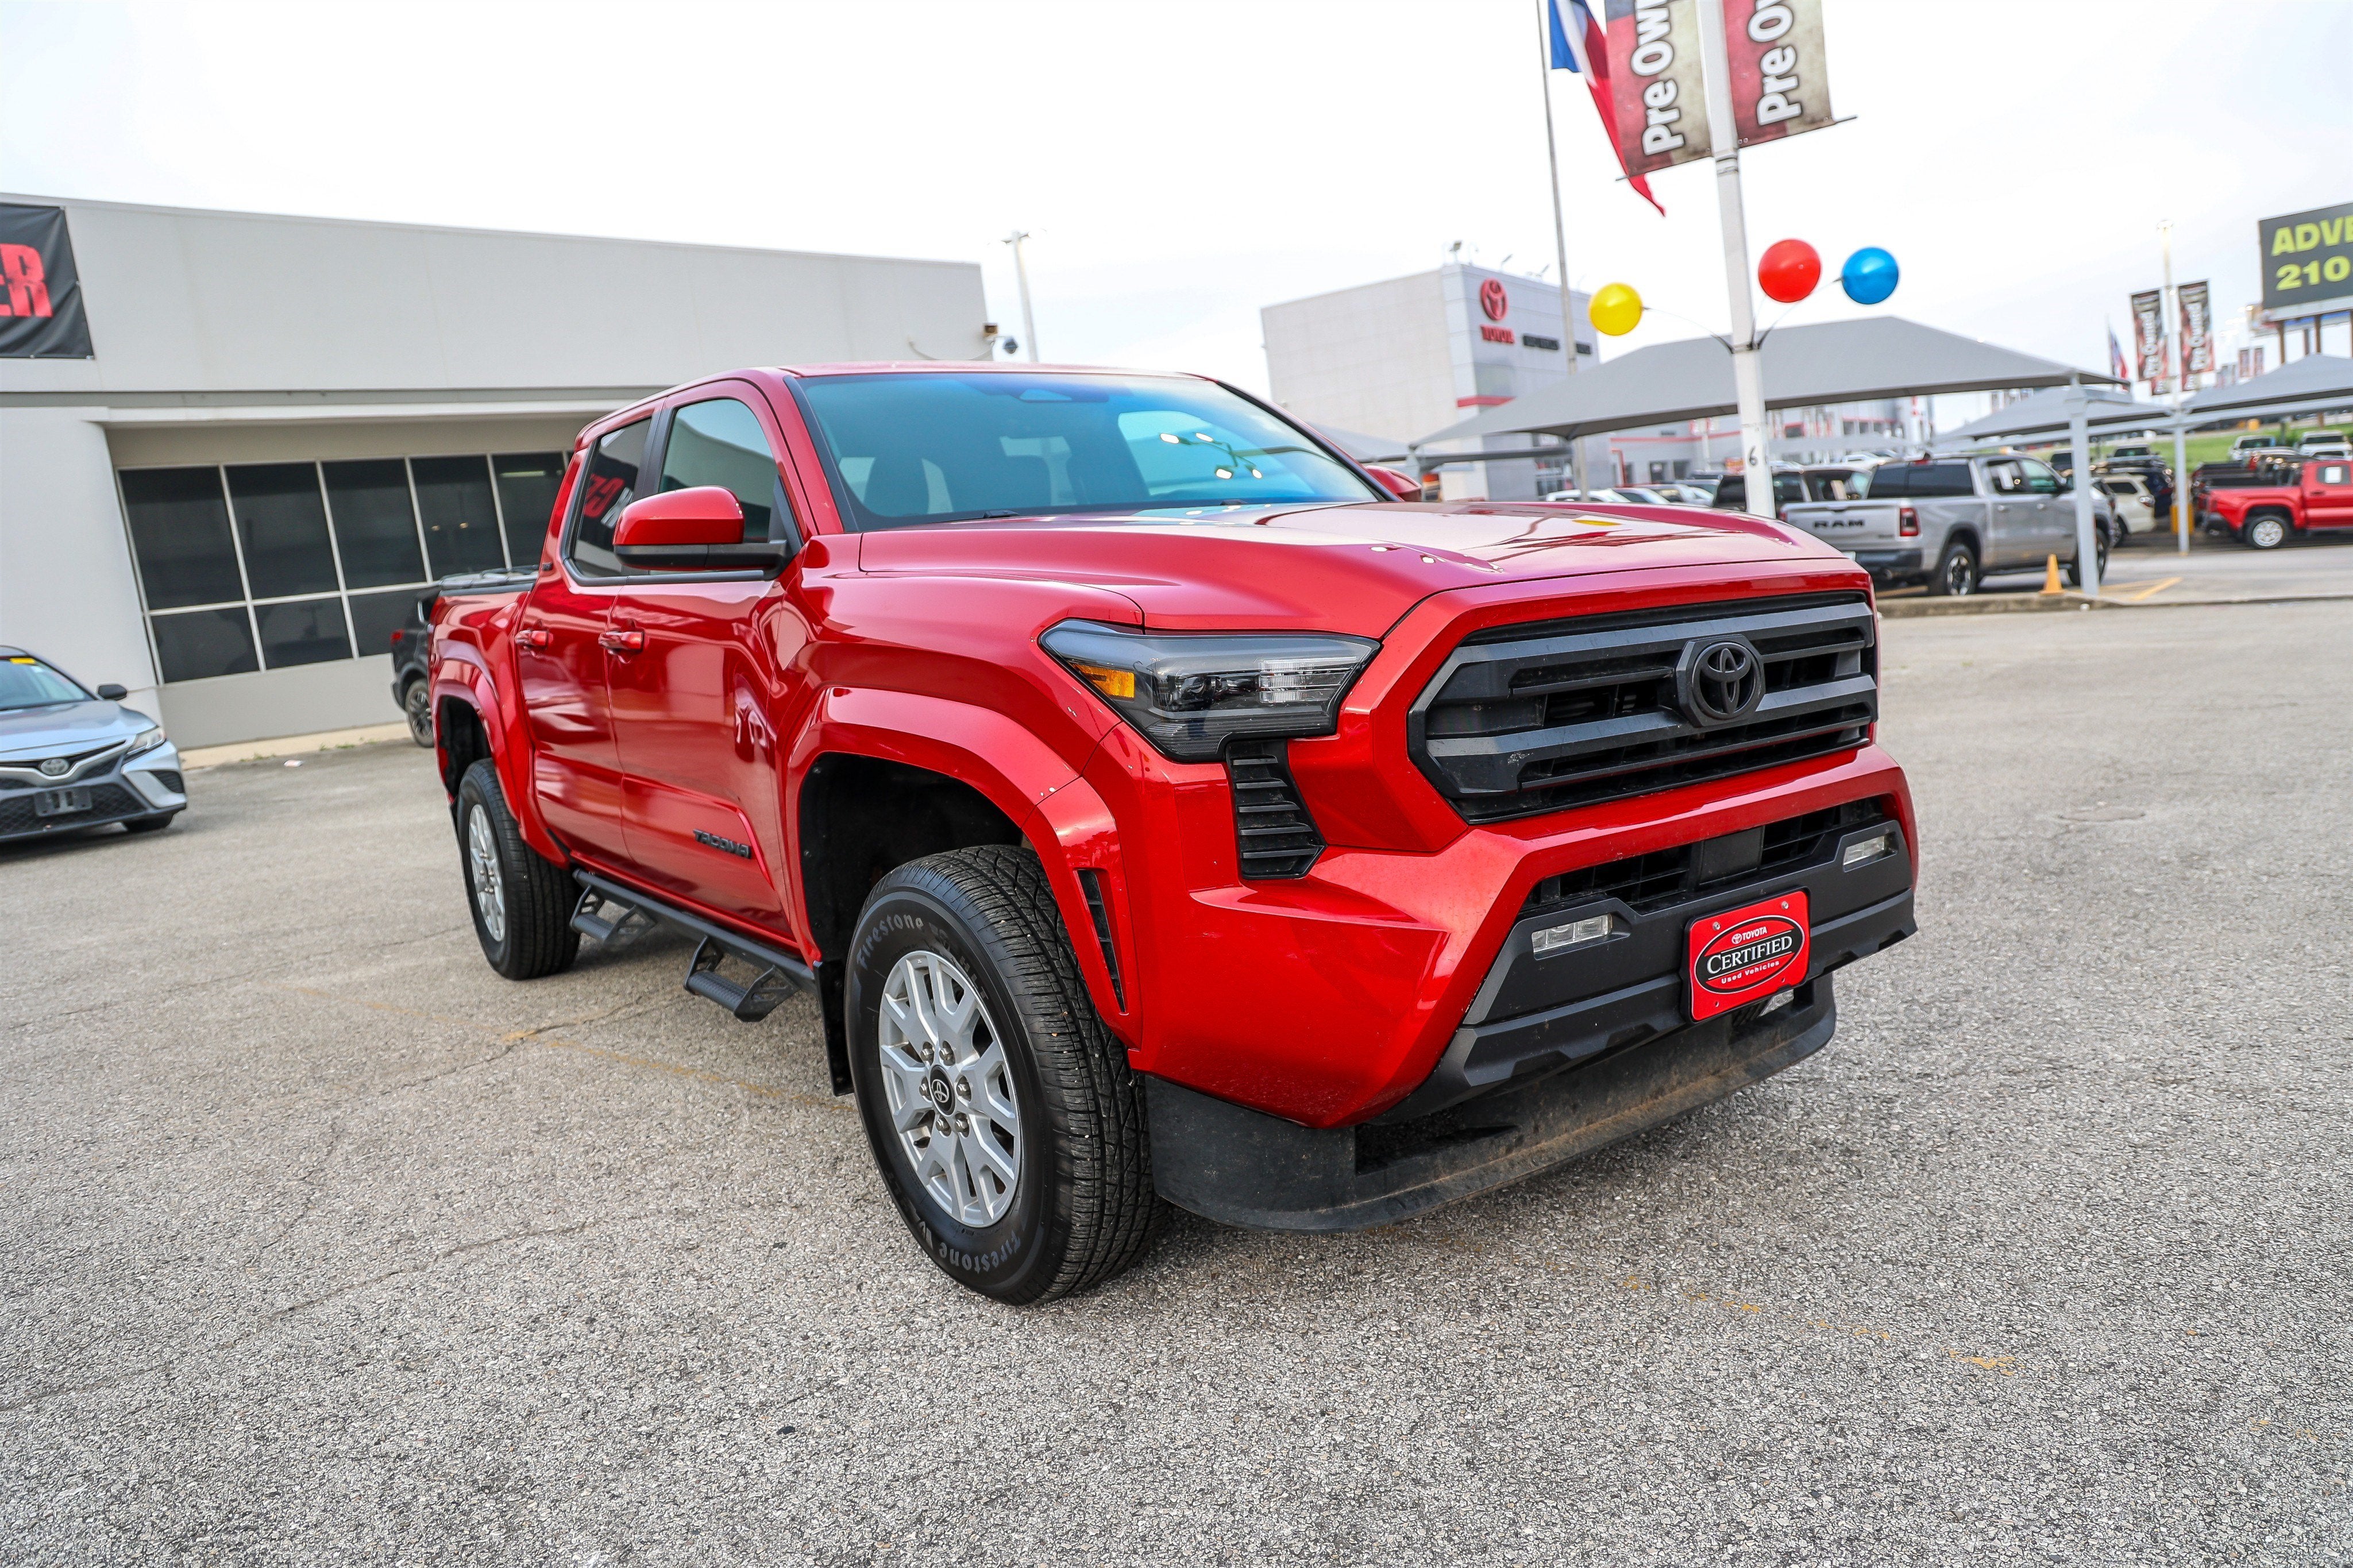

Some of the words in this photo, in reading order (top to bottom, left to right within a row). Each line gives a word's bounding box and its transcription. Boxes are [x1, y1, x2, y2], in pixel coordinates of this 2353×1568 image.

[1756, 45, 1802, 126] Pre
[1641, 79, 1684, 156] Pre
[1814, 519, 1865, 528] RAM
[693, 828, 753, 859] TACOMA
[1742, 926, 1768, 941] TOYOTA
[1721, 972, 1742, 984] Used
[1745, 960, 1780, 976] Vehicles
[938, 1230, 1021, 1275] Firestone
